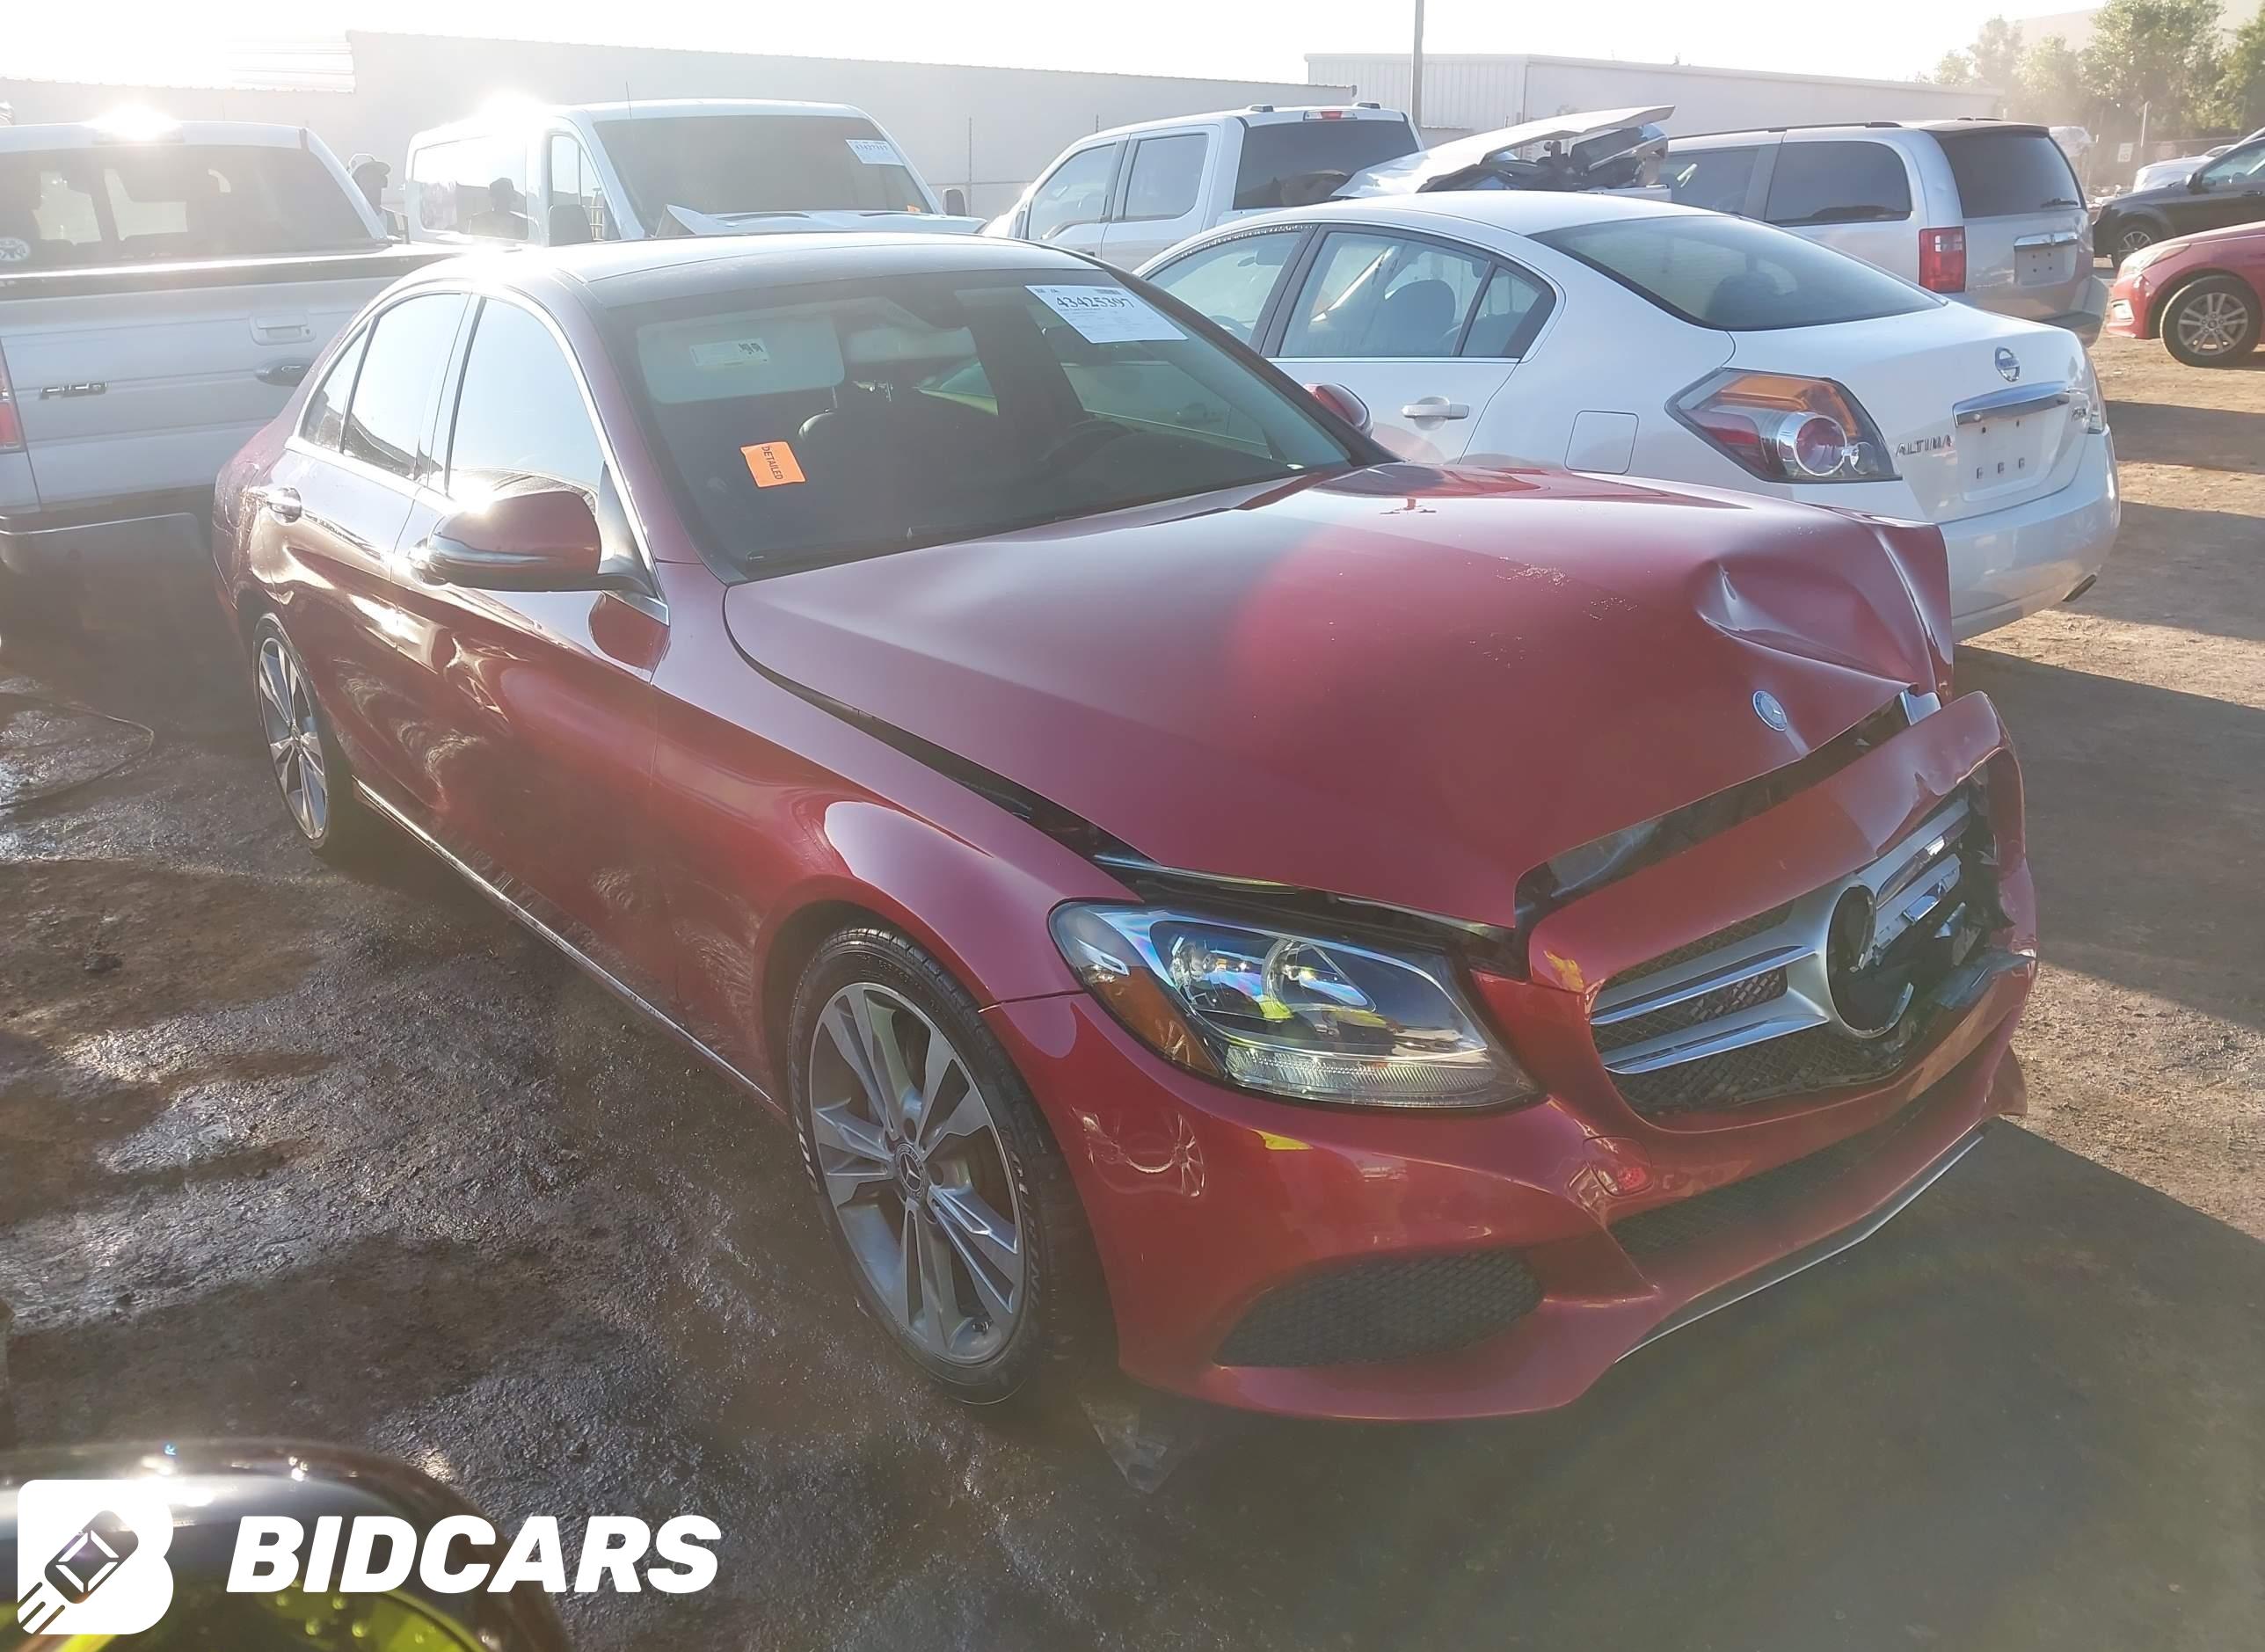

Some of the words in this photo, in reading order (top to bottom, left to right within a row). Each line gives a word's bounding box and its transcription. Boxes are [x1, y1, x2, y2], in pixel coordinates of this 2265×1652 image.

[1056, 296, 1134, 309] 43425397
[1896, 434, 1952, 456] ALTIMA
[761, 446, 783, 480] DETAILED
